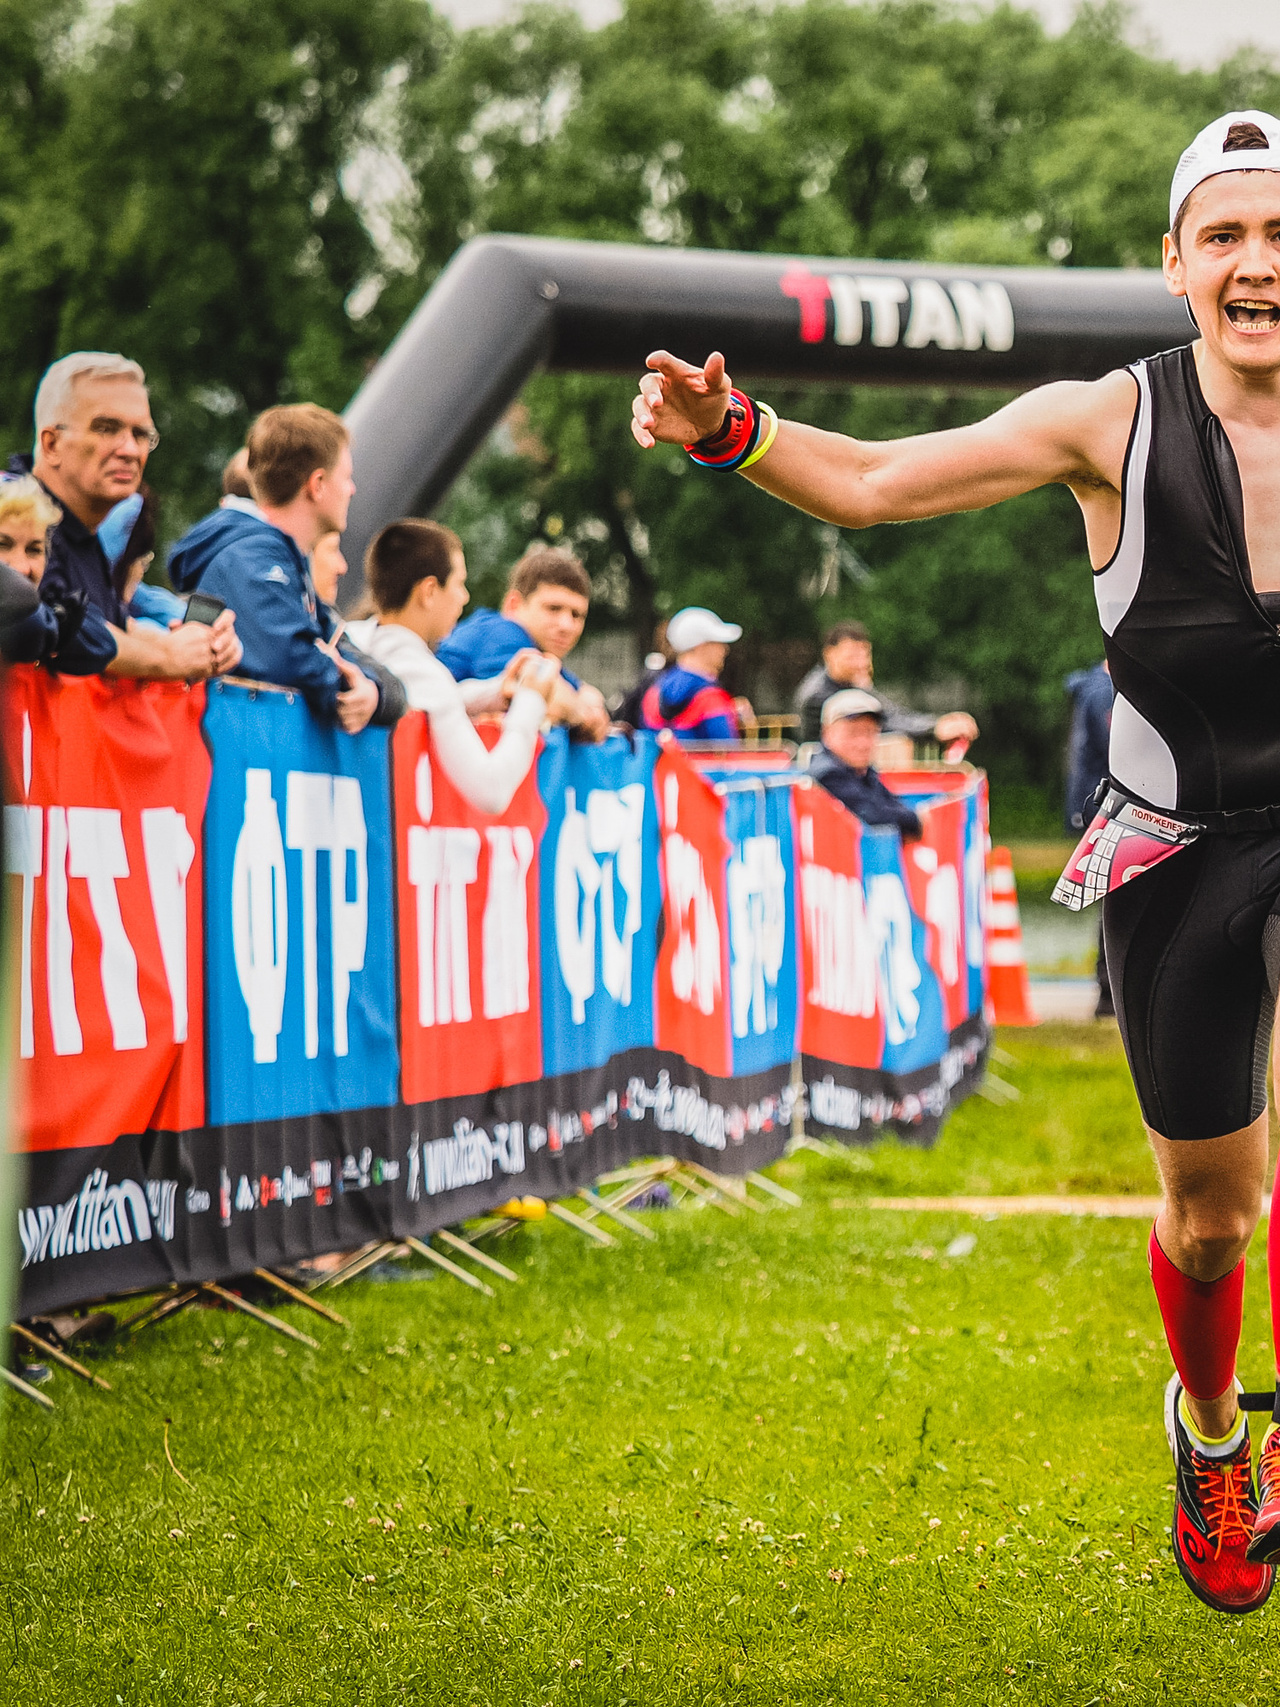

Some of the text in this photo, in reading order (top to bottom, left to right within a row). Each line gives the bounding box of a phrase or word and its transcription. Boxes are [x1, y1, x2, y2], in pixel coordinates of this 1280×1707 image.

[780, 261, 1014, 352] TITAN
[1131, 808, 1185, 833] ПОЛУЖЕЛЕЗ
[231, 767, 367, 1064] ФТР
